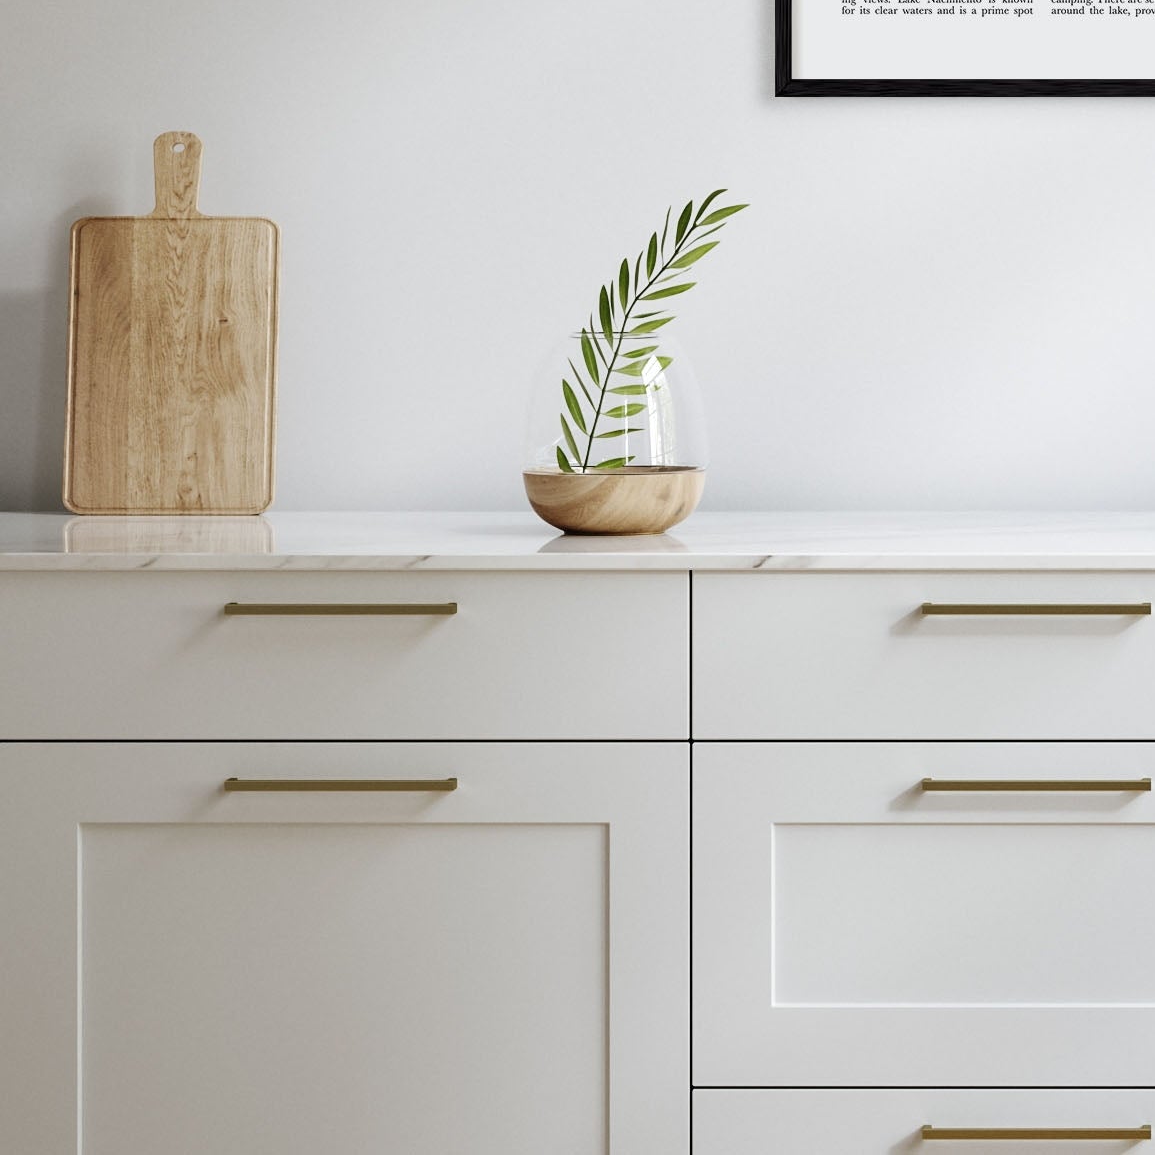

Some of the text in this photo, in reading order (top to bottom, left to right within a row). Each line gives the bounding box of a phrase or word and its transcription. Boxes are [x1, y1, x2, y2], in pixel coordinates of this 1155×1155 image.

[842, 6, 856, 15] for
[860, 6, 871, 15] its
[874, 6, 898, 15] clear
[902, 7, 933, 15] waters
[937, 6, 955, 15] and
[960, 6, 967, 15] is
[981, 6, 1009, 17] prime
[1014, 7, 1033, 17] spot
[1051, 6, 1085, 15] around
[1090, 6, 1104, 15] the
[1109, 6, 1131, 16] lake,
